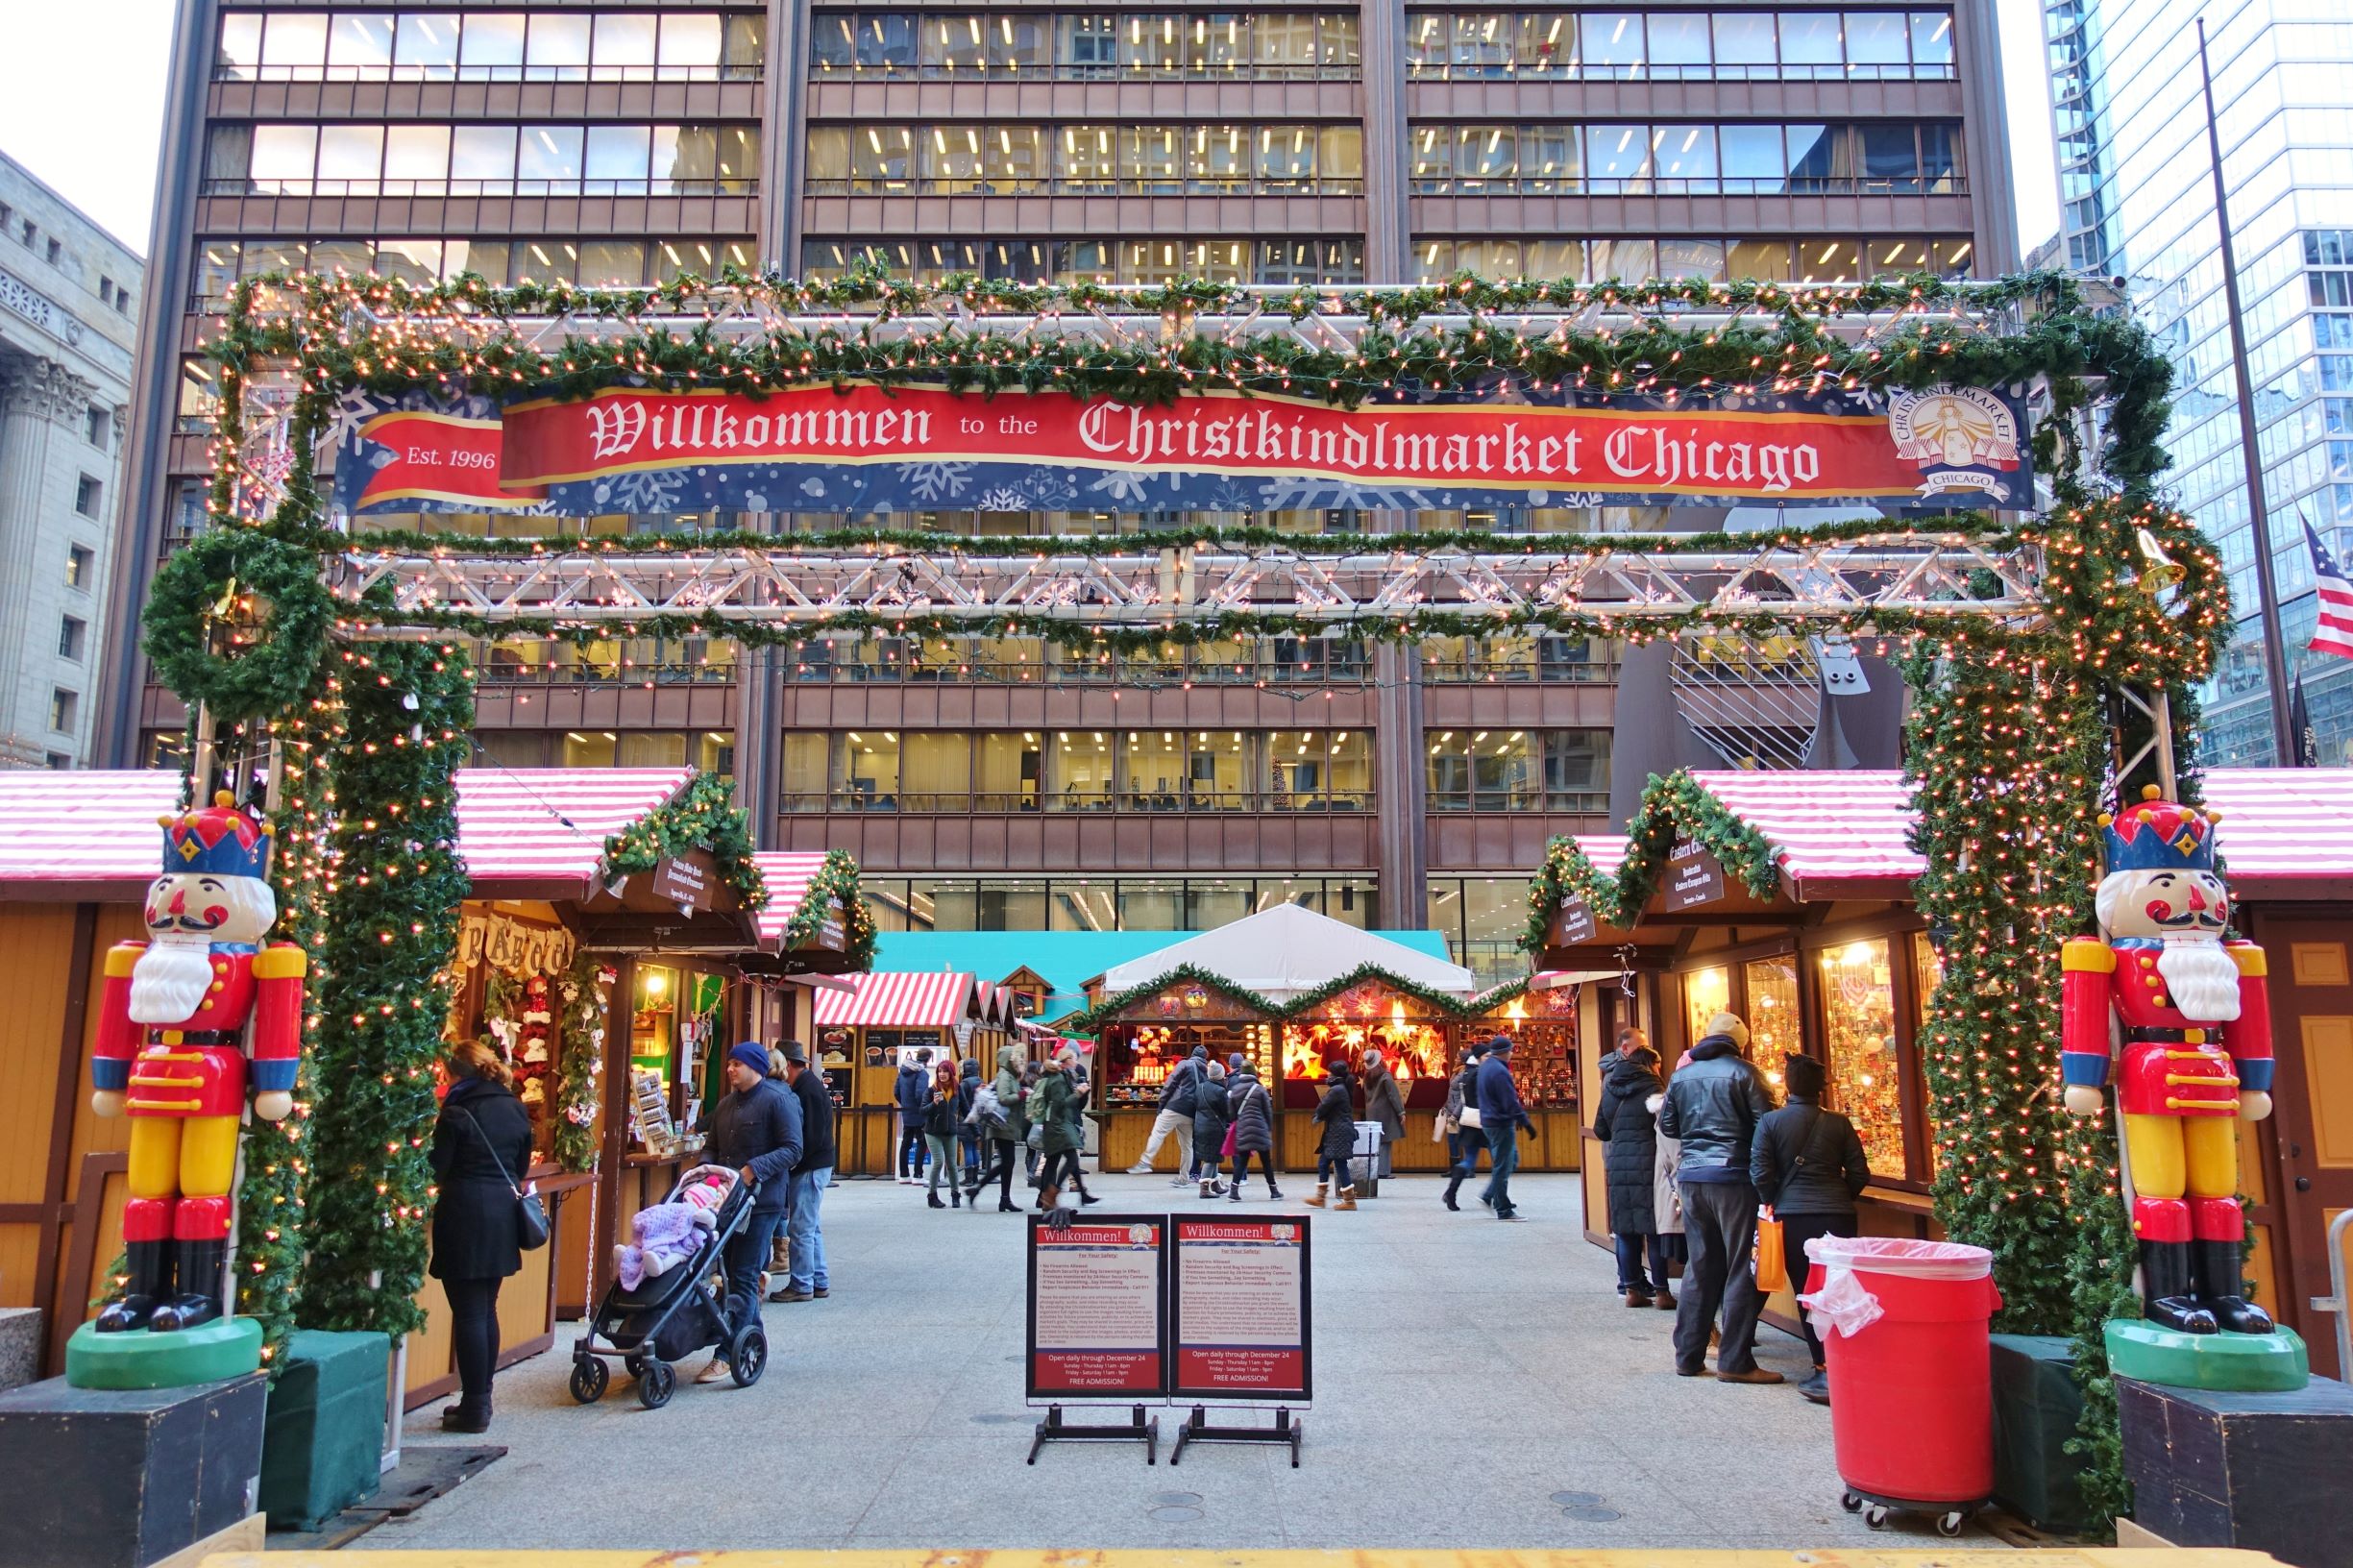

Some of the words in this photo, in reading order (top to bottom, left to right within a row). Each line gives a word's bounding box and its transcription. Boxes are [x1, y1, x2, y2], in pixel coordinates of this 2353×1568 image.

[586, 400, 932, 461] Willkommen
[959, 416, 985, 435] to
[999, 415, 1038, 435] the
[1078, 400, 1583, 477] Christkindlmarket
[1605, 424, 1820, 493] Chicago
[406, 446, 445, 467] Est.
[449, 448, 497, 471] 1996
[1932, 473, 1991, 487] CHICAGO
[1043, 1230, 1121, 1242] Willkommen!
[1186, 1225, 1263, 1238] Willkommen!
[1048, 1354, 1066, 1362] Open
[1066, 1354, 1081, 1362] daily
[1081, 1354, 1106, 1362] through
[1106, 1354, 1137, 1362] December
[1191, 1350, 1210, 1359] Open
[1210, 1350, 1224, 1359] daily
[1225, 1350, 1249, 1359] through
